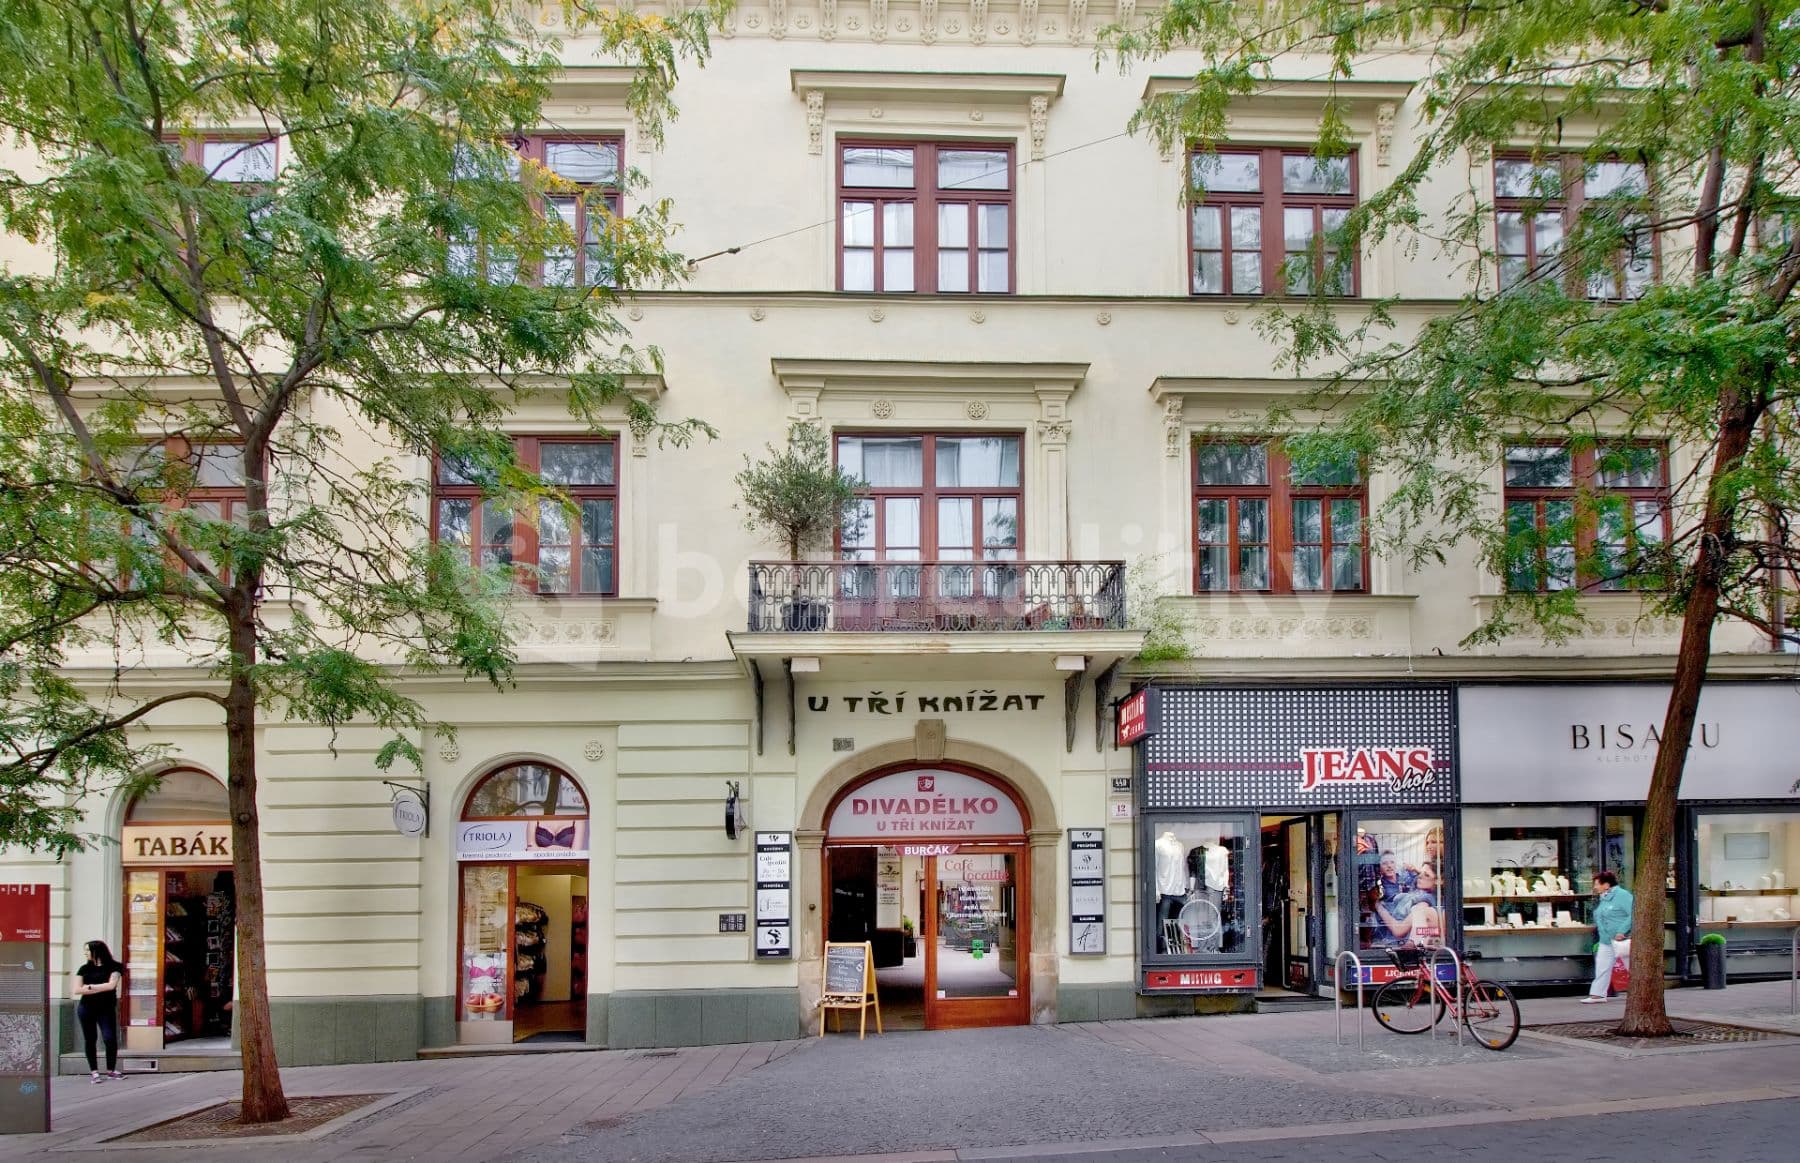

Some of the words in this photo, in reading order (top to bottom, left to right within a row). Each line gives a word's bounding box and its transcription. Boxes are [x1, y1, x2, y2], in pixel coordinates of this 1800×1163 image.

[808, 696, 829, 712] U
[843, 690, 908, 715] TŘÍ
[918, 689, 1045, 713] KNÍŽAT
[1571, 723, 1720, 750] BISAU
[1302, 750, 1429, 789] JEANS
[1392, 767, 1435, 793] shop
[852, 793, 998, 816] DIVADÉLKO
[877, 821, 886, 831] U
[891, 818, 914, 831] TŘÍ
[919, 817, 976, 831] KNÍŽAT
[134, 831, 228, 856] TABÁK
[468, 832, 507, 841] TRIOLA
[904, 844, 950, 855] BURČÁK
[944, 859, 974, 873] Café
[1180, 973, 1222, 985] MUSTANG
